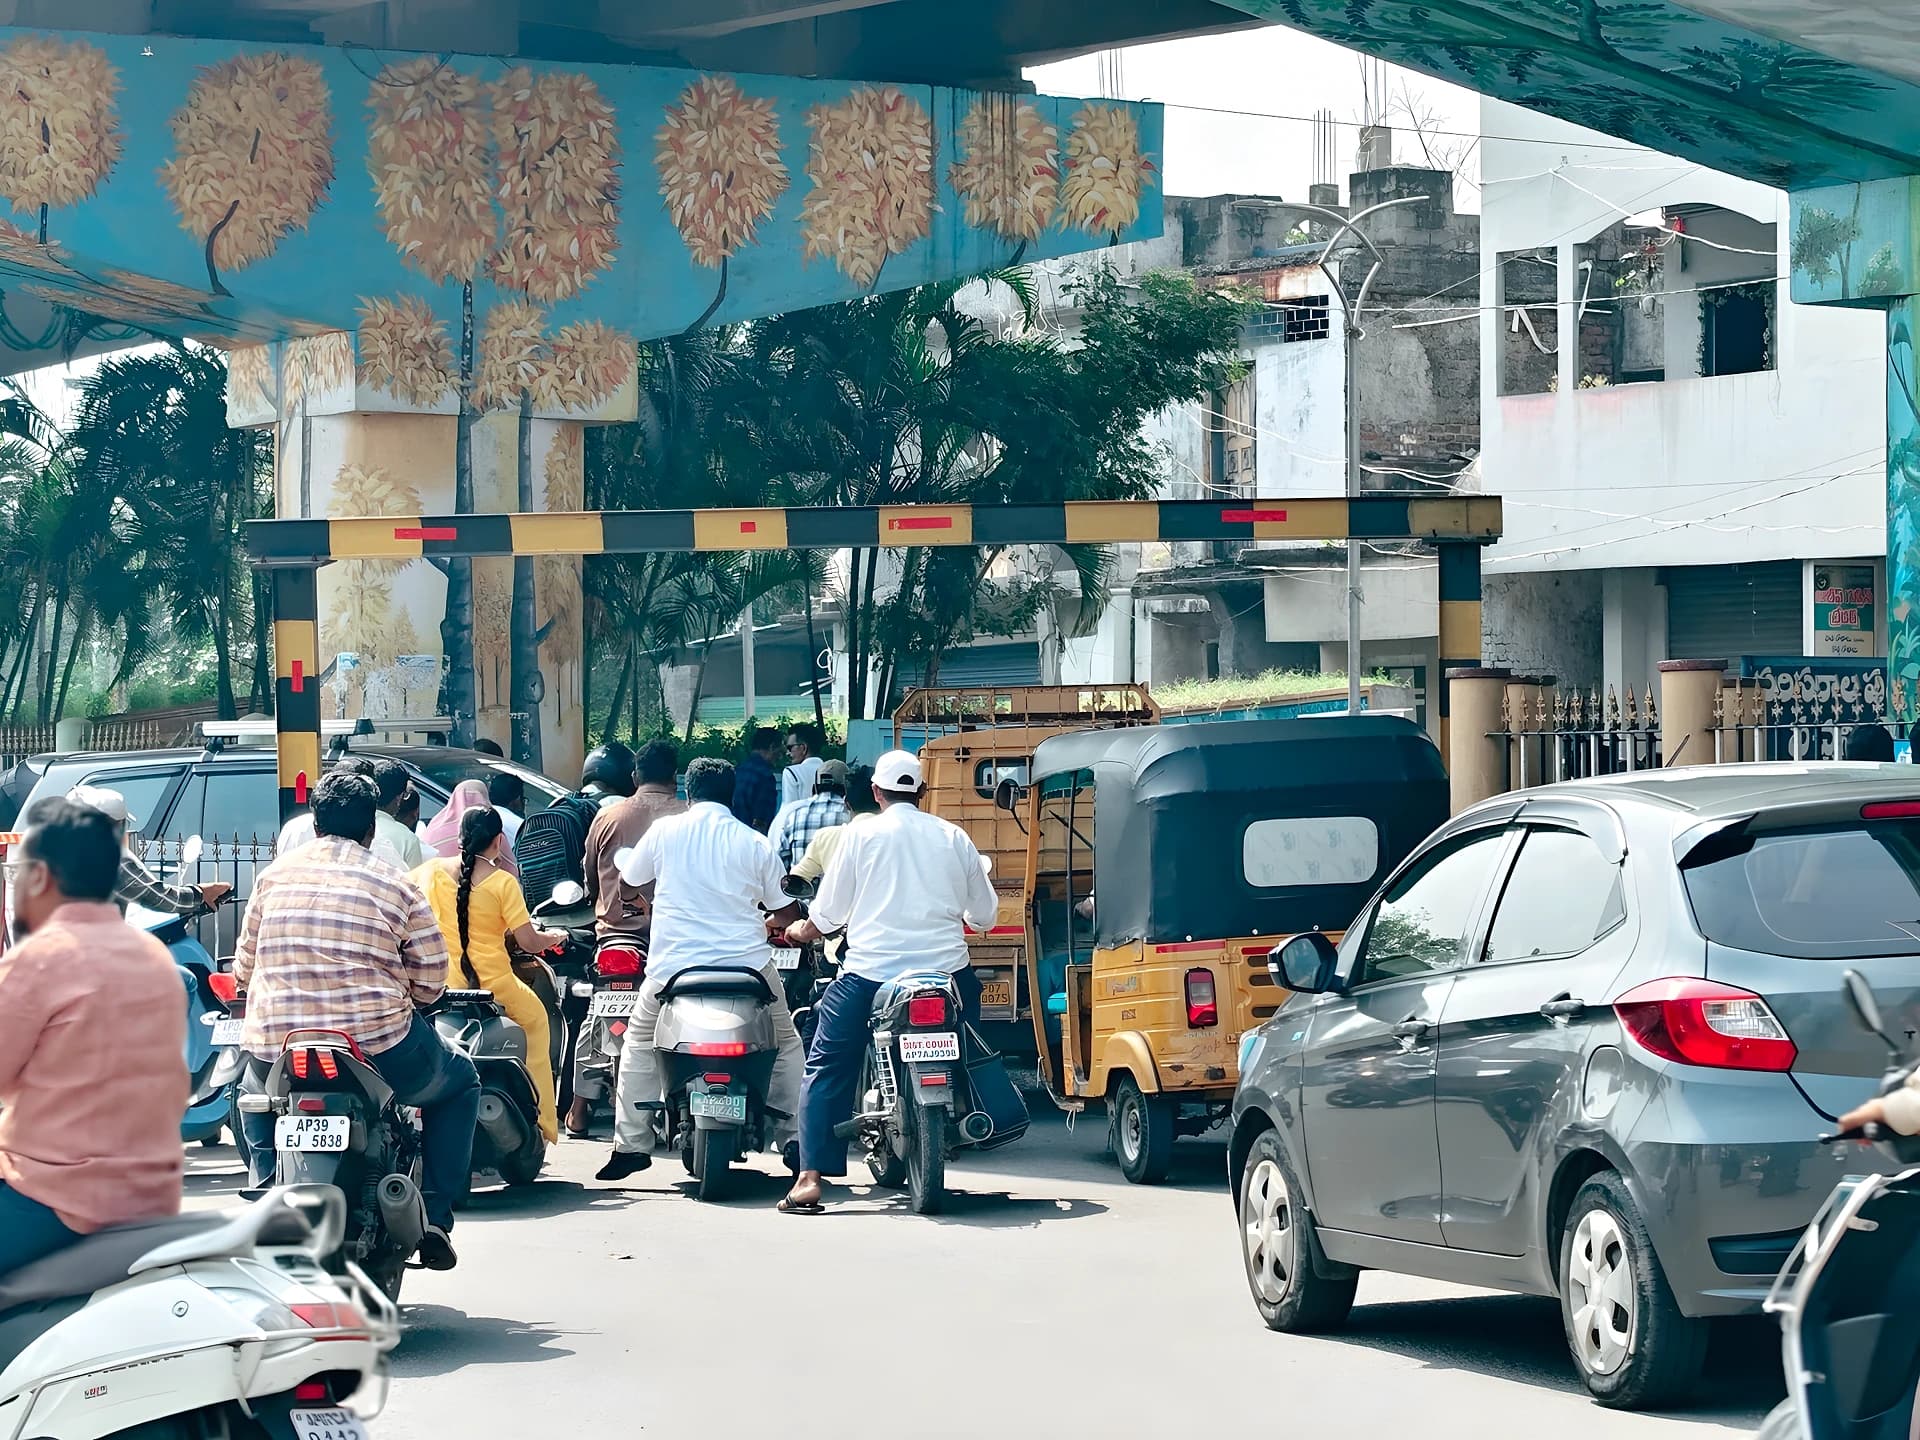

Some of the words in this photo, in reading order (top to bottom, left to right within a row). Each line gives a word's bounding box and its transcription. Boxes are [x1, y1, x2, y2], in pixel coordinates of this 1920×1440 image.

[295, 1119, 329, 1131] AP39
[286, 1135, 301, 1148] EJ
[312, 1134, 342, 1148] 5838
